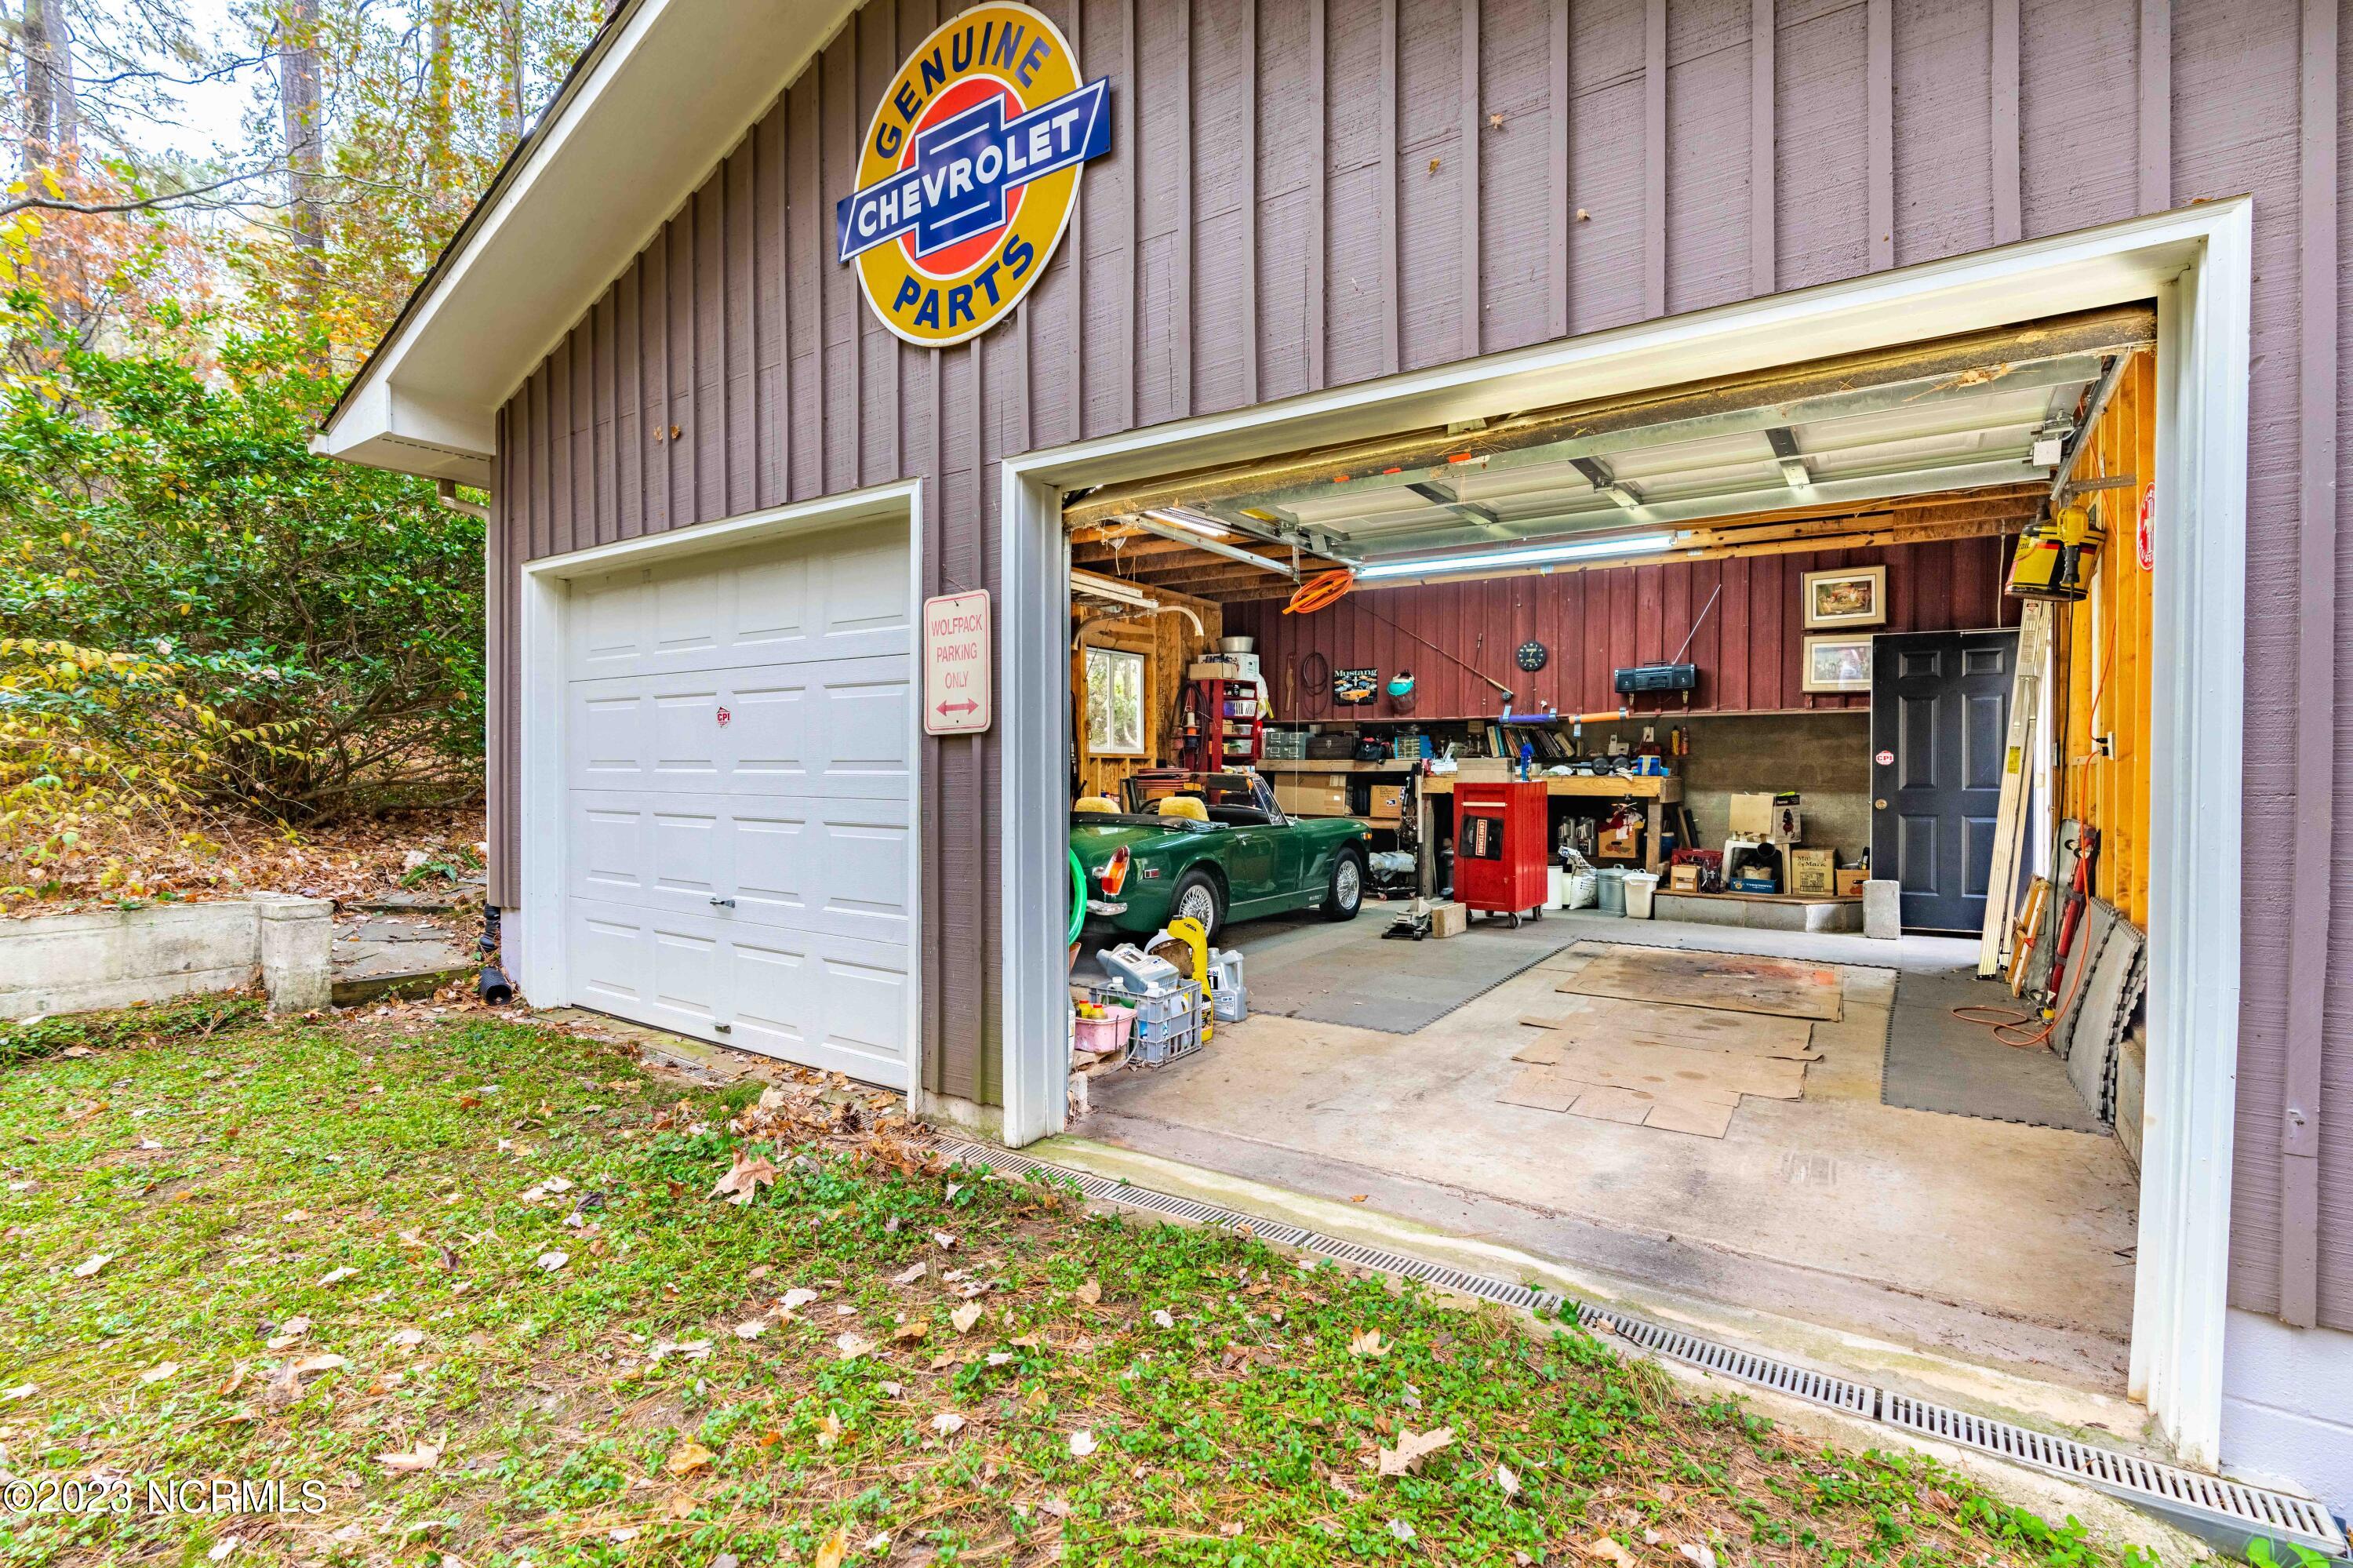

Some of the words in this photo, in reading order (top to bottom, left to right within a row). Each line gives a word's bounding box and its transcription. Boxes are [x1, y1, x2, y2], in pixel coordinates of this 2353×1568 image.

[875, 20, 1052, 159] GENUINE
[858, 107, 1079, 237] CHEVROLET
[893, 234, 1035, 330] PARTS
[931, 614, 983, 636] WOLFPACK
[936, 642, 977, 663] PARKING
[944, 671, 969, 689] ONLY
[1334, 669, 1377, 678] Mustang
[1209, 976, 1214, 988] 1
